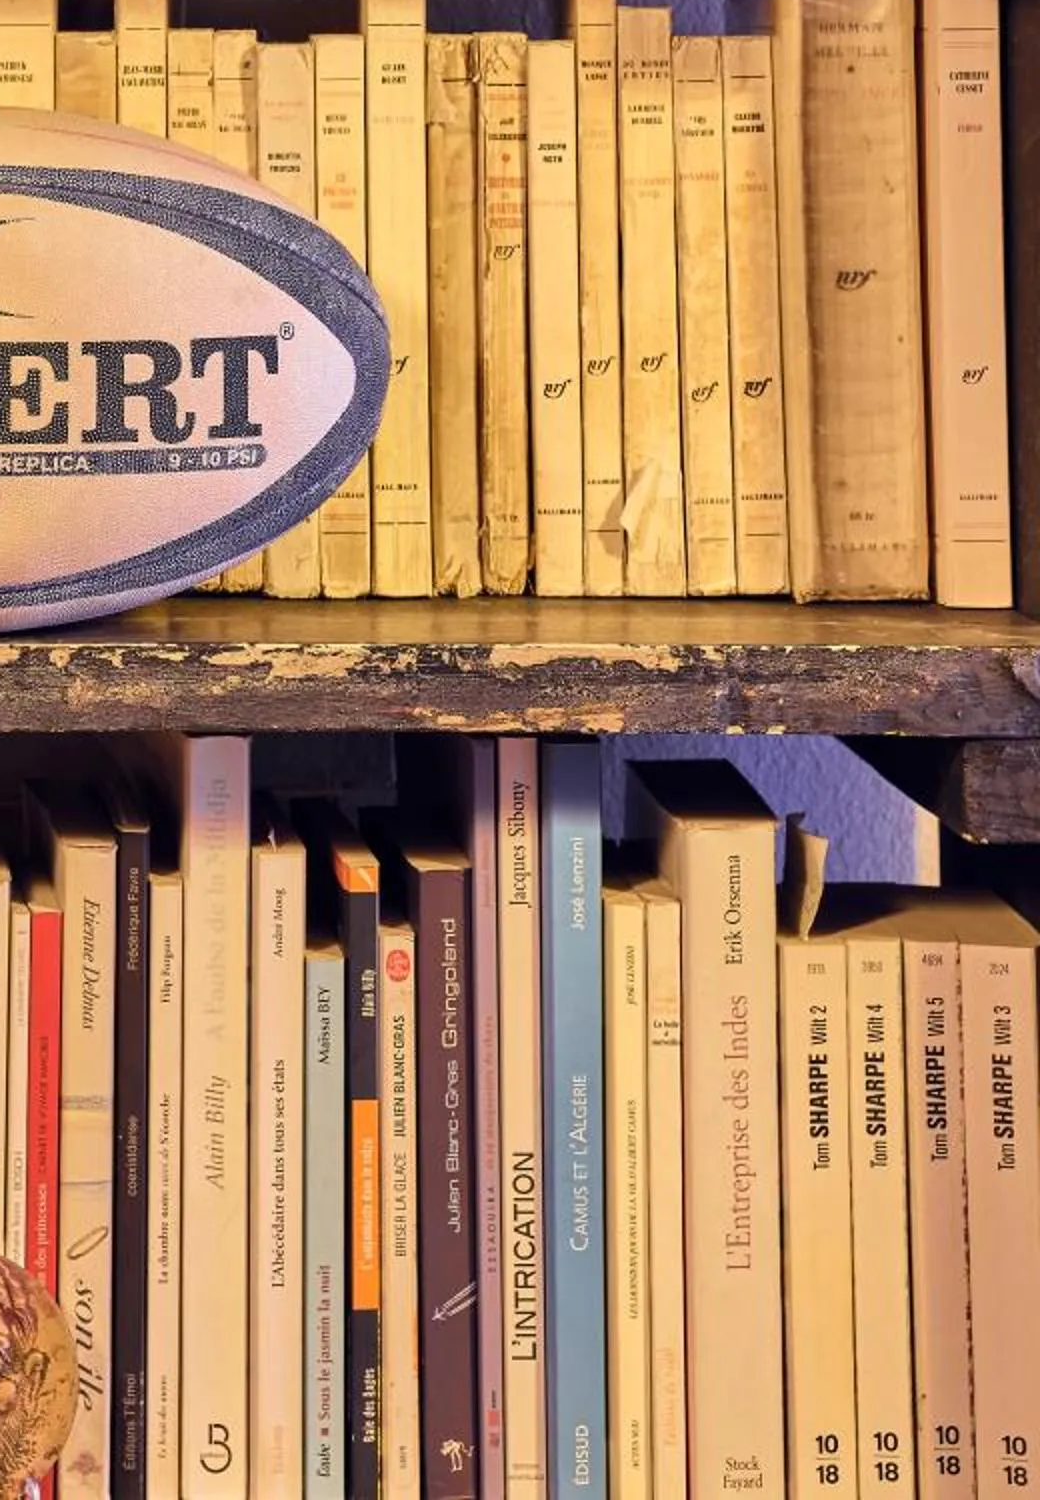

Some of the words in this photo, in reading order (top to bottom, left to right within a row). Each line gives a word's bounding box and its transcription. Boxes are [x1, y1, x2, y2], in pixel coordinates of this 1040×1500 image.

[168, 450, 180, 470] 9
[200, 450, 222, 469] 10
[228, 448, 258, 468] PSI
[506, 780, 530, 837] Sibony
[507, 844, 530, 908] Jacques
[570, 837, 585, 892] Lenzini
[724, 855, 744, 925] Orsenna
[570, 898, 585, 931] José
[722, 931, 744, 966] Erik
[440, 918, 459, 1048] Gringoland
[725, 995, 750, 1062] Indes
[809, 1005, 827, 1014] 2
[867, 1004, 885, 1013] 4
[994, 1005, 1012, 1014] 3
[809, 1019, 827, 1045] Wilt
[867, 1017, 884, 1043] Wilt
[994, 1018, 1012, 1045] Wilt
[204, 1075, 232, 1125] Billy
[727, 1070, 751, 1110] des
[808, 1054, 830, 1137] SHARPE
[865, 1052, 886, 1135] SHARPE
[992, 1054, 1014, 1138] SHARPE
[444, 1060, 460, 1172] Blanc-Gras
[204, 1132, 225, 1190] Alain
[571, 1161, 588, 1179] ET
[812, 1142, 830, 1170] Tom
[869, 1141, 887, 1168] Tom
[997, 1143, 1016, 1171] Tom
[445, 1177, 462, 1233] Julien
[725, 1115, 756, 1271] L'Entreprise
[569, 1186, 589, 1251] CAMUS
[511, 1151, 539, 1361] L'INTRICATION
[572, 1425, 591, 1485] ÉDISUD
[816, 1434, 838, 1453] 10
[723, 1475, 763, 1492] Fayard
[725, 1457, 760, 1472] Stock
[817, 1465, 839, 1484] 18
